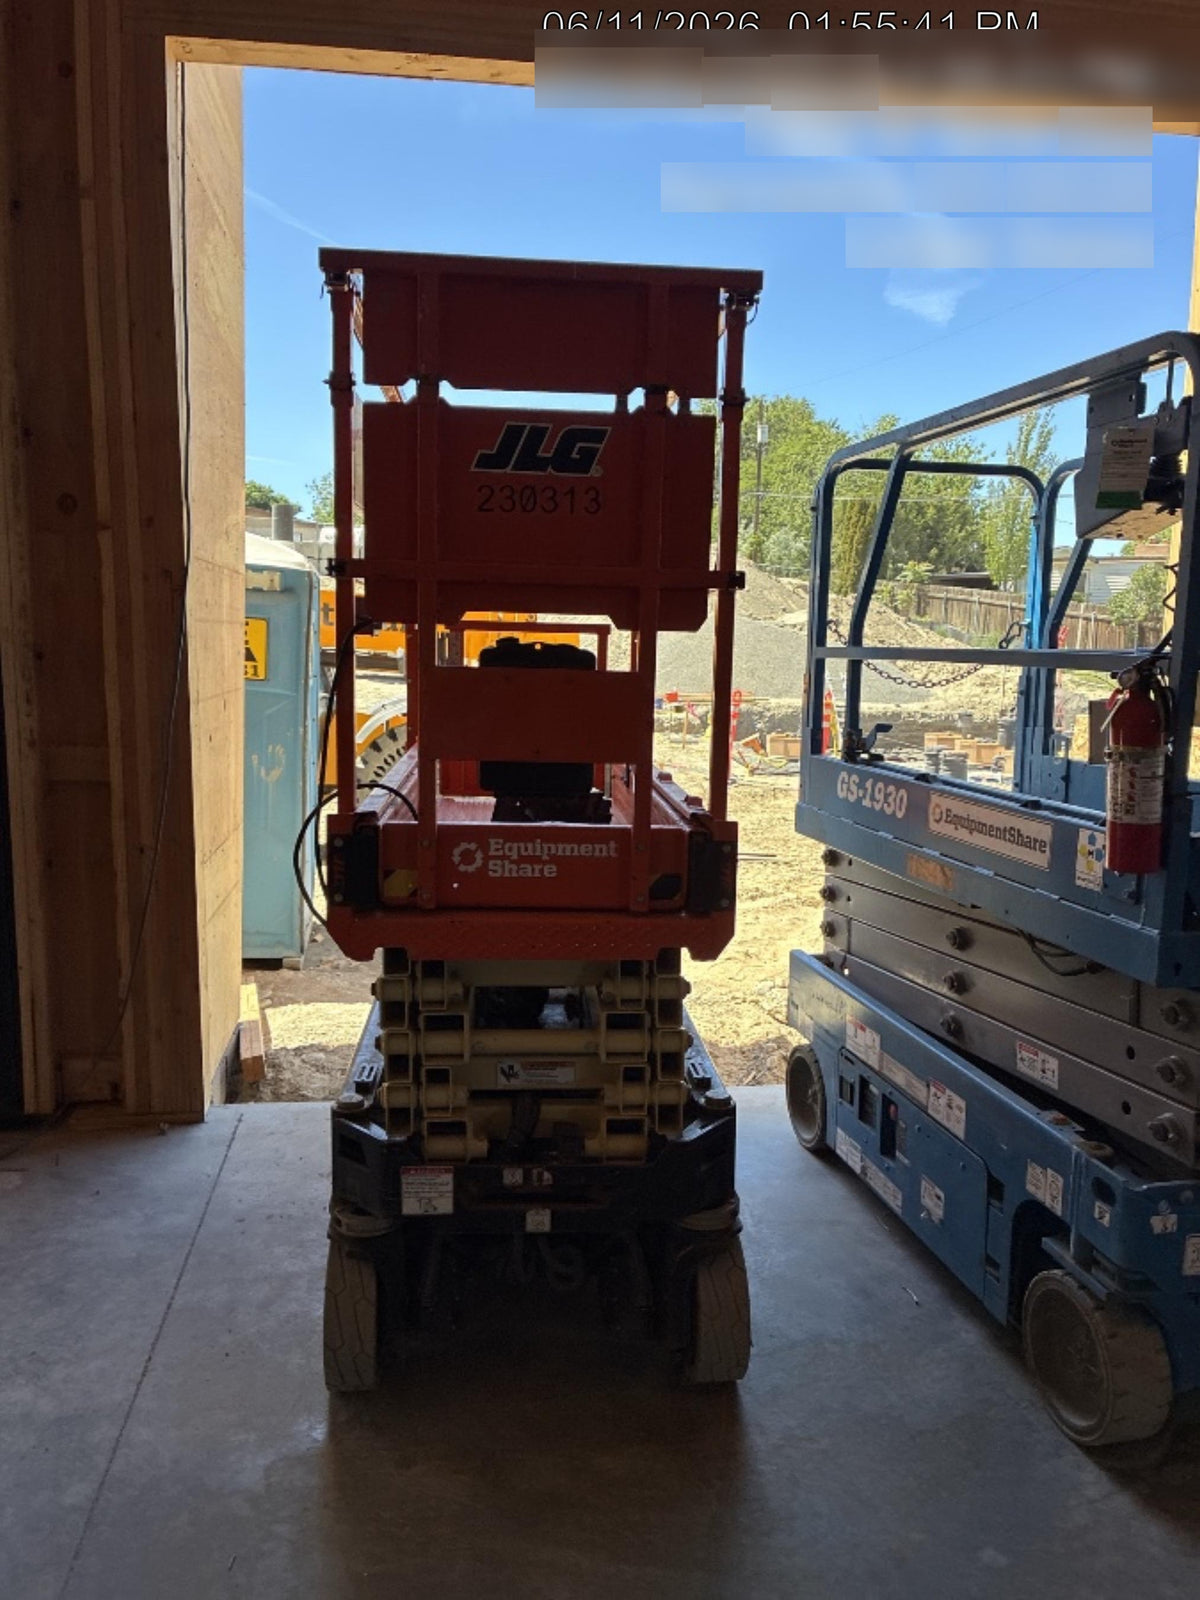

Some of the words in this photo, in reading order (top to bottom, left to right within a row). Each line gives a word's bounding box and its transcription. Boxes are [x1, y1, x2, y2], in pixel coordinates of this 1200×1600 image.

[470, 421, 612, 477] JLG
[477, 484, 602, 515] 230313
[836, 770, 908, 820] GS-1930
[487, 837, 619, 860] Equipment
[943, 805, 1049, 856] EquipmentShare
[487, 859, 558, 878] Share
